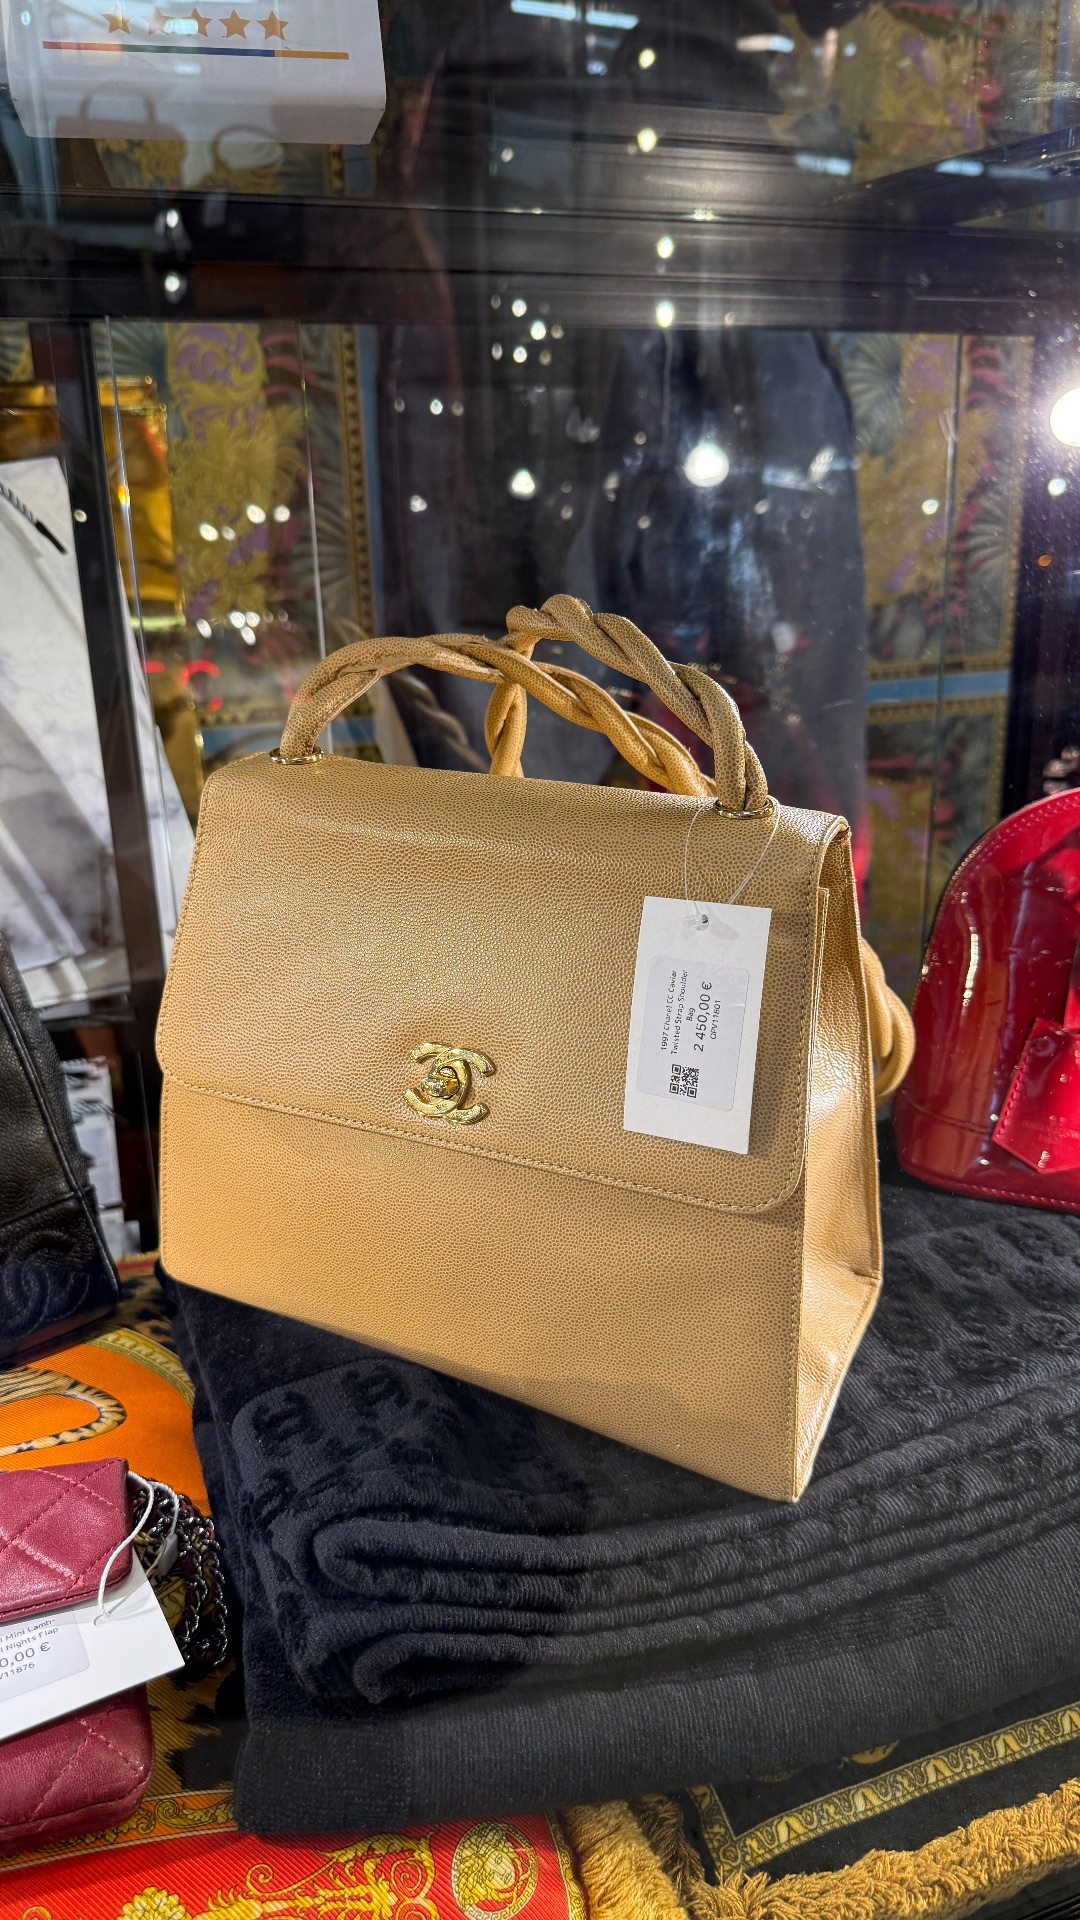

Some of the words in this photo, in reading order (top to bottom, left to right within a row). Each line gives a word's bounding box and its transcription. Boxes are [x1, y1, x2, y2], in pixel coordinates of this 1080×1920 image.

[668, 970, 677, 993] Caviar
[678, 969, 688, 1002] Shoulder
[701, 981, 712, 991] €
[667, 994, 674, 1004] CC
[664, 1005, 672, 1031] Chanel
[675, 1003, 685, 1024] Strap
[686, 1007, 695, 1021] Bag
[695, 993, 711, 1041] 450,00
[661, 1031, 669, 1051] 1997
[671, 1026, 681, 1055] Twisted
[693, 1043, 704, 1052] 2
[5, 1629, 25, 1641] Mini
[28, 1619, 56, 1632] Lamb-
[6, 1635, 37, 1651] Nights
[38, 1627, 59, 1638] Flap
[40, 1641, 51, 1652] €
